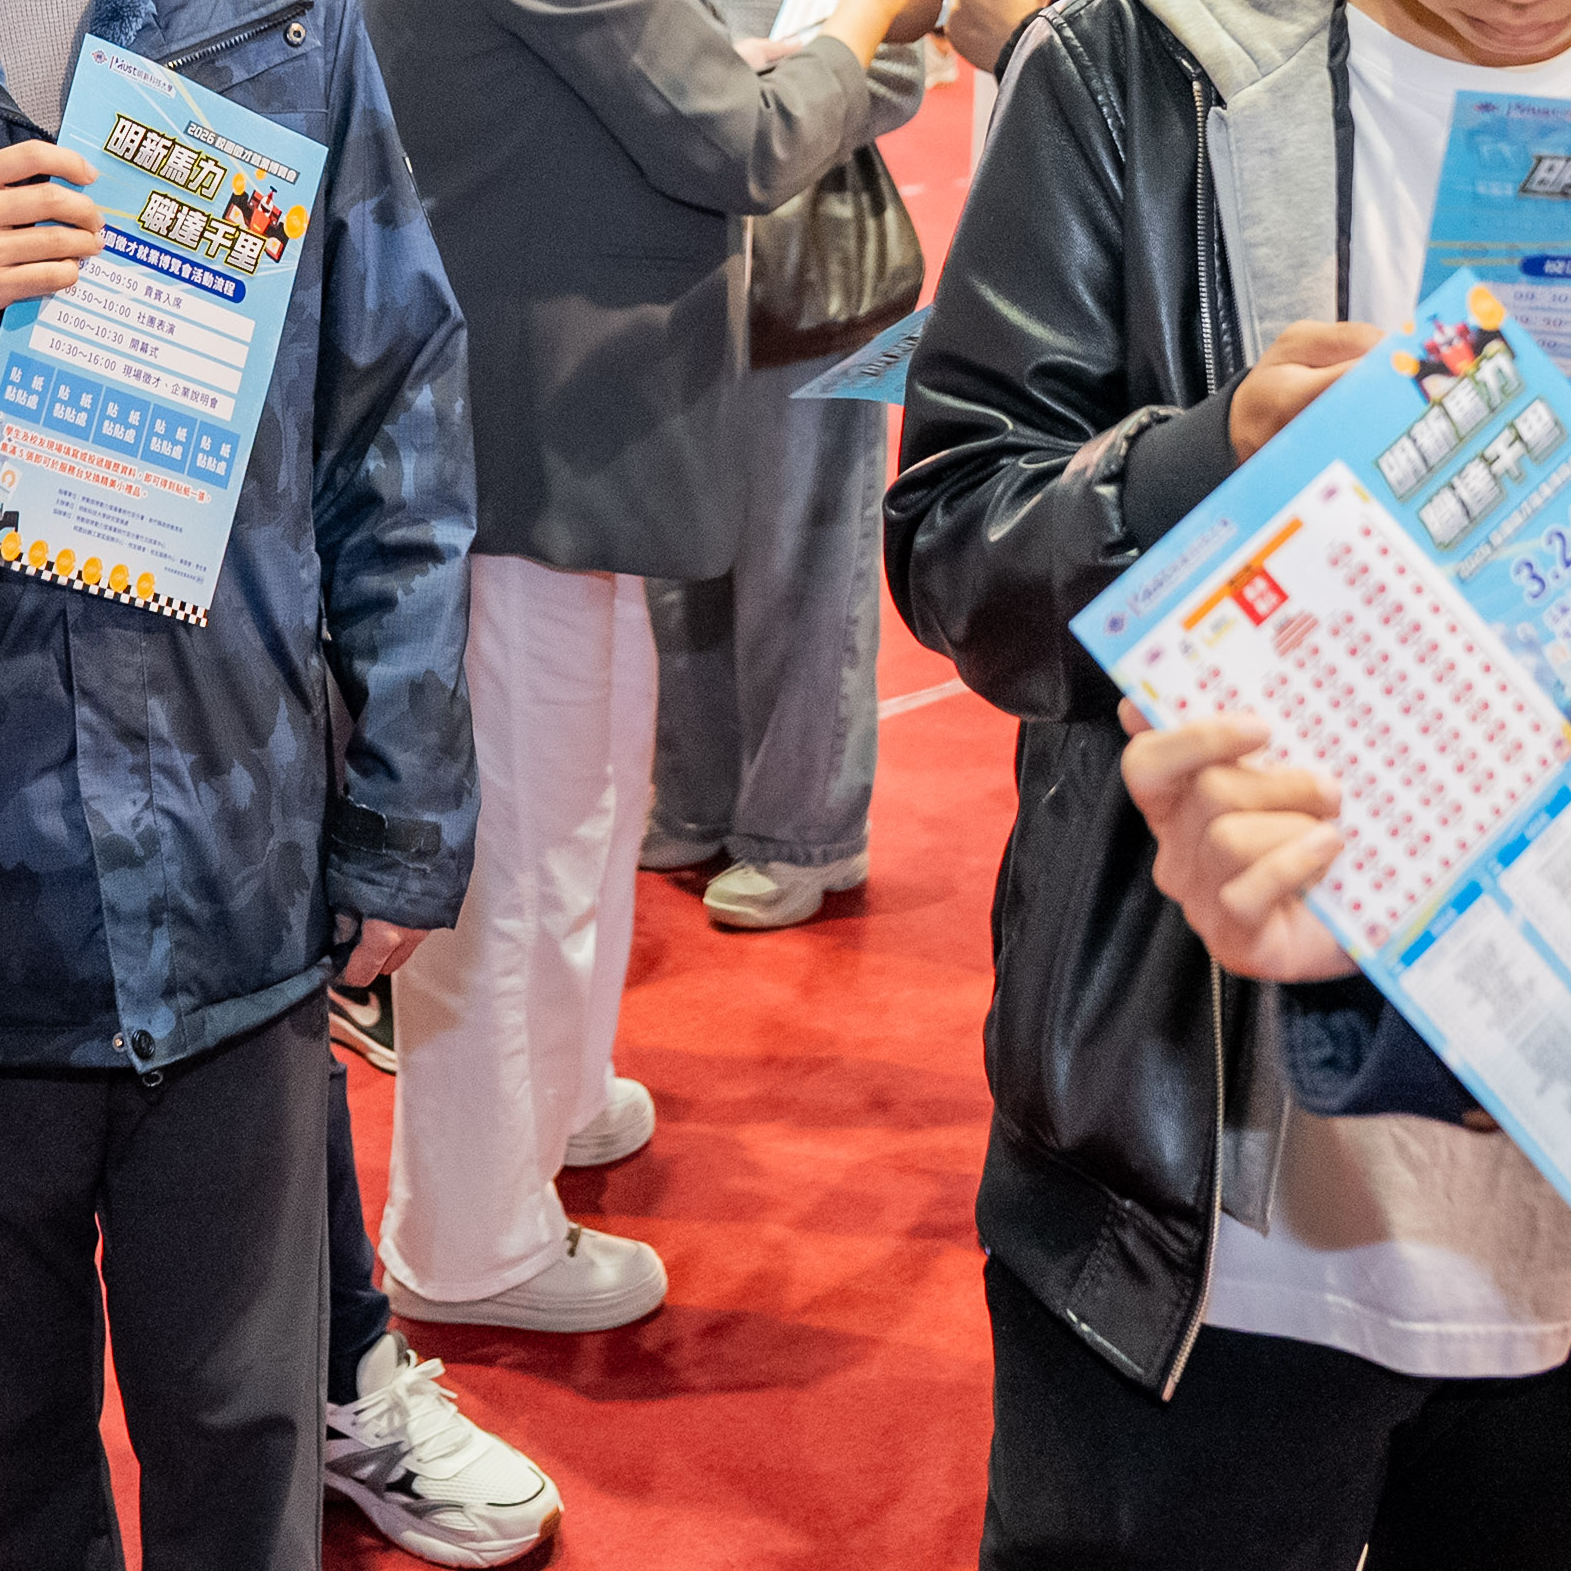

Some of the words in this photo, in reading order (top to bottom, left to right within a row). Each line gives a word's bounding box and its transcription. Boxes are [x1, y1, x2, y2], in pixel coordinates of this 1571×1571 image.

[187, 123, 215, 145] 2026
[105, 116, 227, 200] 明新馬力
[140, 192, 267, 273] 職達千里
[137, 312, 176, 335] 社團表演
[130, 338, 160, 359] 開幕式
